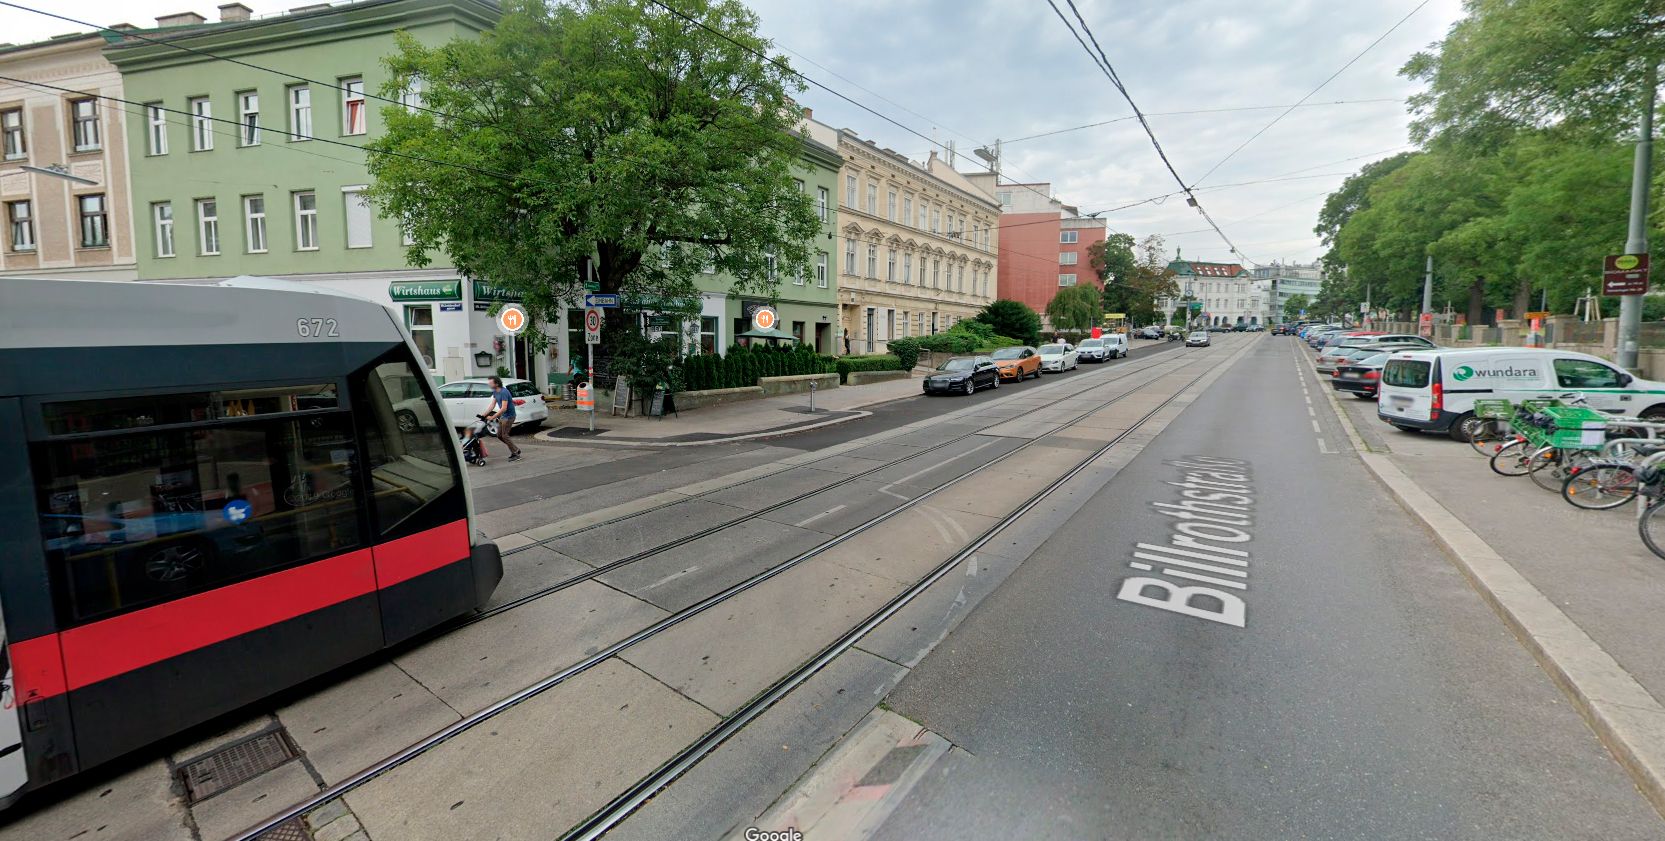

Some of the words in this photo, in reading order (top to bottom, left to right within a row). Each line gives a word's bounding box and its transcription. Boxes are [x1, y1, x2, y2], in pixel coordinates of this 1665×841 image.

[393, 286, 441, 296] Wirtshaus
[590, 315, 597, 326] 30
[296, 317, 340, 338] 672
[587, 333, 599, 342] Zone
[1475, 366, 1536, 377] wundara
